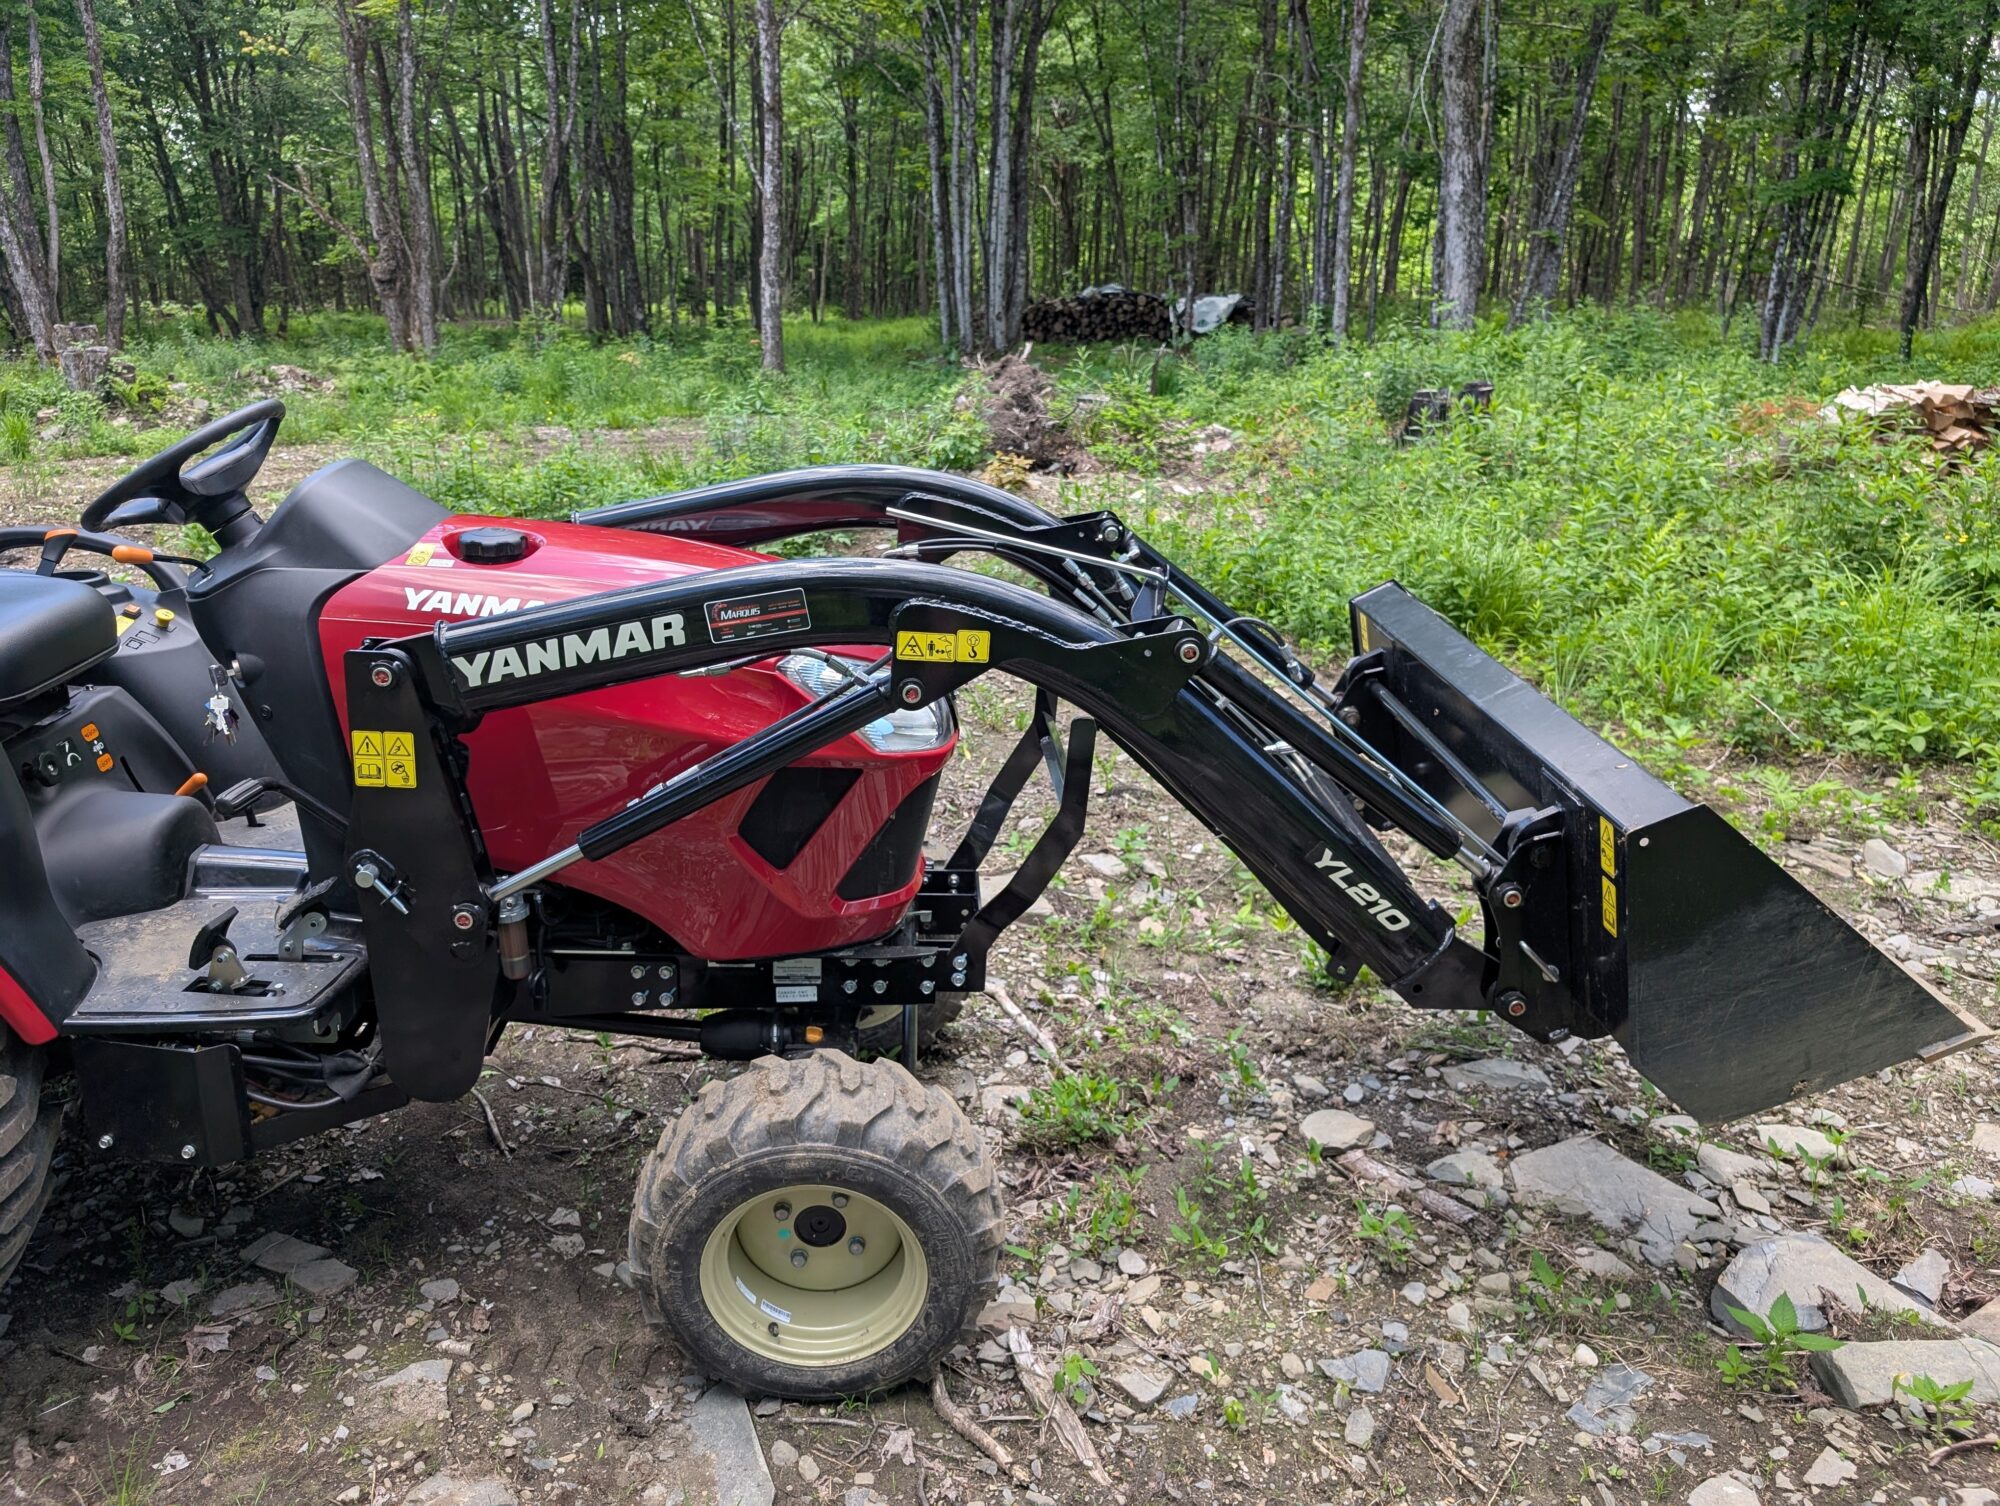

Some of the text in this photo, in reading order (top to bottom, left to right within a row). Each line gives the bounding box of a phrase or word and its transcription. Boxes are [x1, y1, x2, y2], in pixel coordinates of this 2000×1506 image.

[451, 613, 687, 688] YANMAR
[720, 606, 761, 621] MARQUIS
[1313, 847, 1411, 932] YL210
